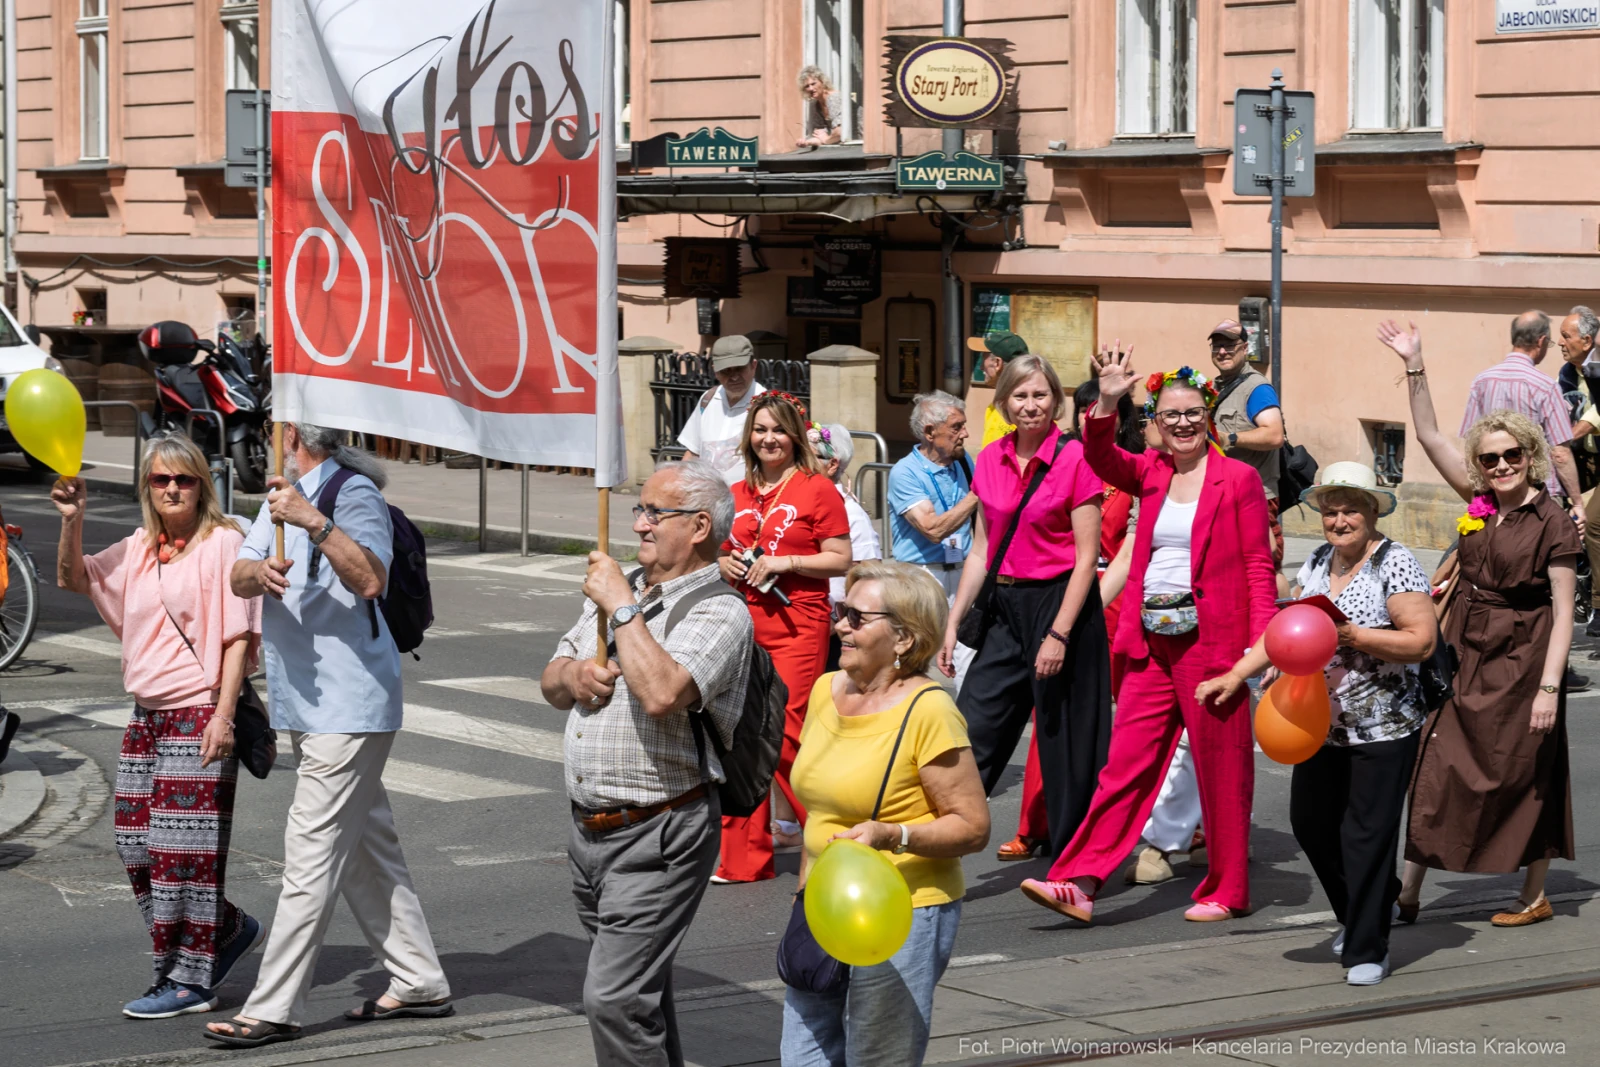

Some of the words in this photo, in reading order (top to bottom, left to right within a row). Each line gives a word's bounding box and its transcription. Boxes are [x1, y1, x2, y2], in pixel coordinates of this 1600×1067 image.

[1499, 7, 1597, 27] JABŁONOWSKICH
[926, 64, 950, 73] Tawerna
[911, 74, 949, 101] Stary
[950, 76, 978, 96] Port
[672, 145, 751, 161] TAWERNA
[904, 167, 996, 181] TAWERNA
[841, 242, 872, 250] CREATED
[826, 279, 850, 287] ROYAL
[850, 279, 870, 287] NAVY
